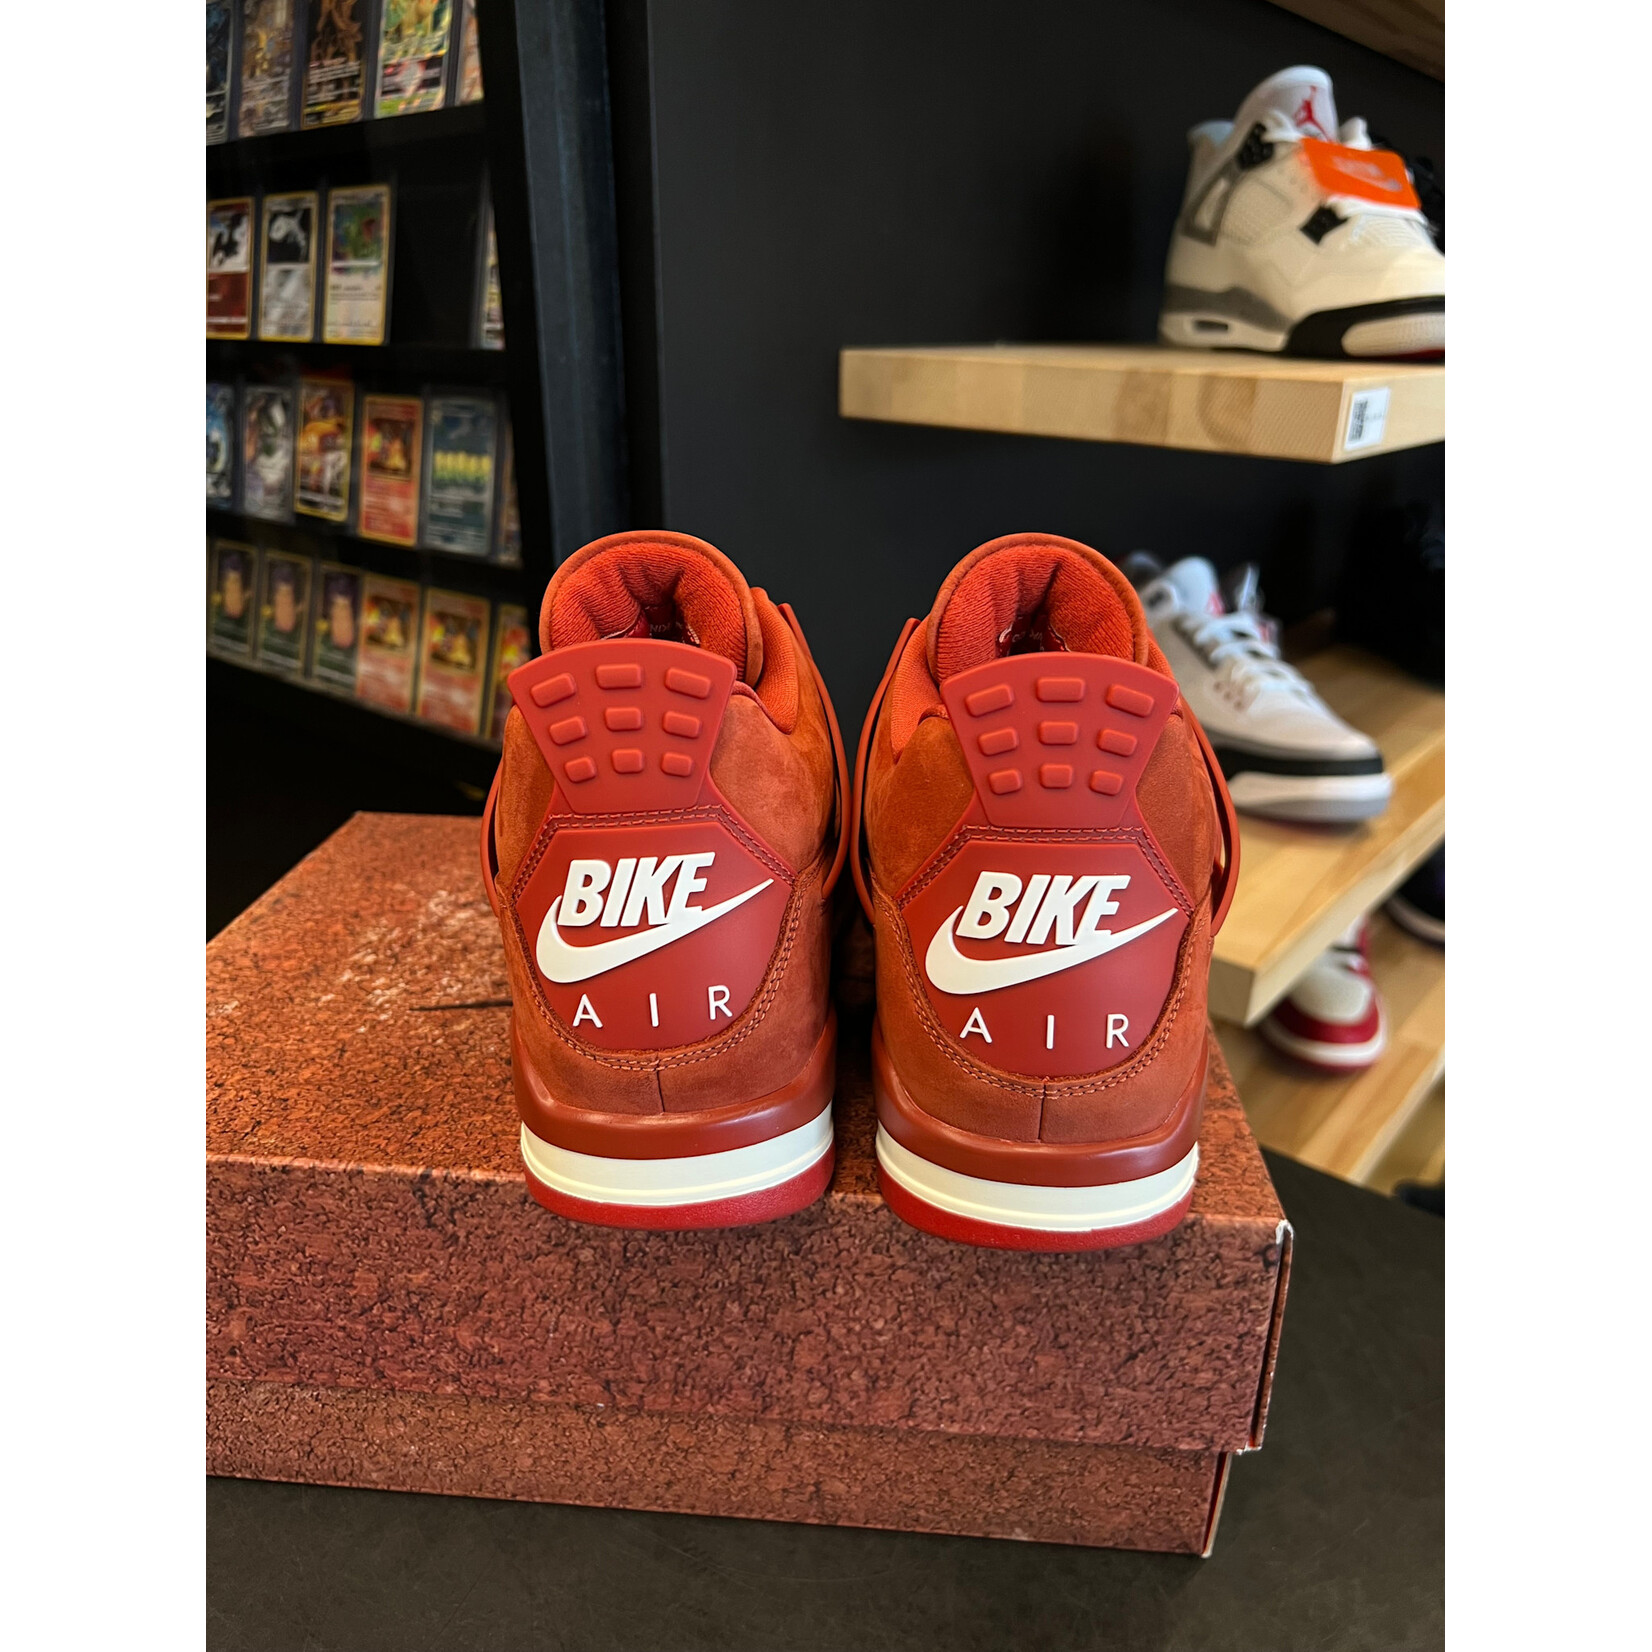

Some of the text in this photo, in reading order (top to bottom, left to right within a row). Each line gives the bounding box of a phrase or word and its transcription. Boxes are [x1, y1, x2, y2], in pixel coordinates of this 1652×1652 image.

[557, 851, 716, 928] BIKE
[955, 870, 1132, 946] BIKE
[571, 984, 734, 1029] AIR
[959, 1006, 1130, 1050] AIR
